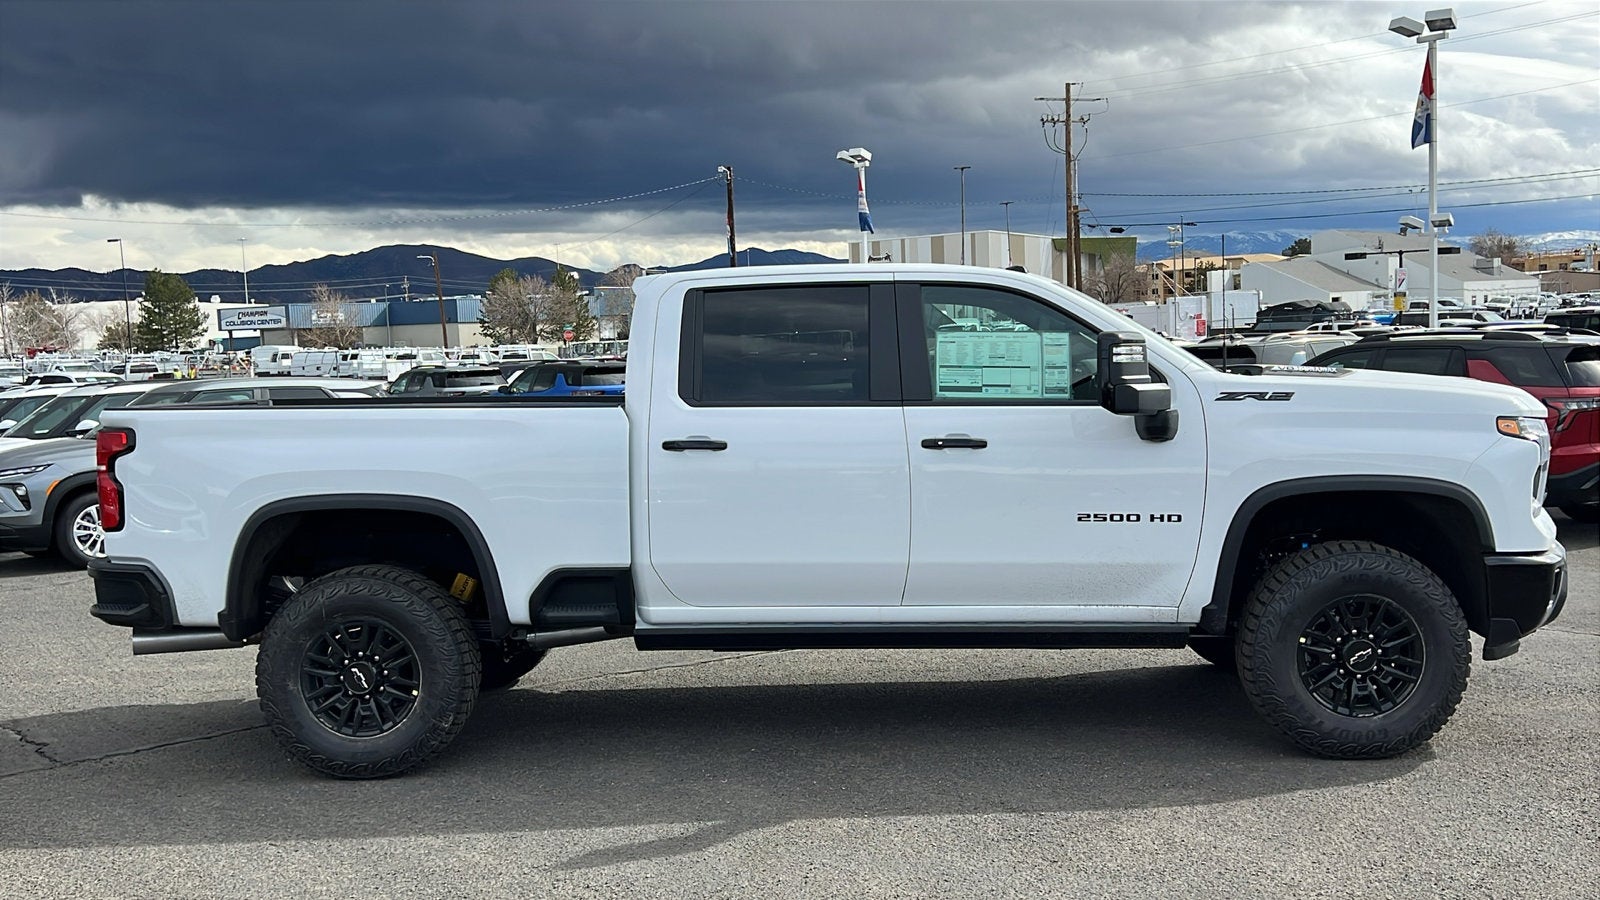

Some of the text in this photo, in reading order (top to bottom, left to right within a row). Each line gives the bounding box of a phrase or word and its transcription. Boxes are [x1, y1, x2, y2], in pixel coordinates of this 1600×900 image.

[238, 310, 268, 319] CHAMPION
[225, 319, 257, 327] COLLISION
[1214, 392, 1295, 401] ZR2
[1077, 513, 1182, 522] 2500 HD
